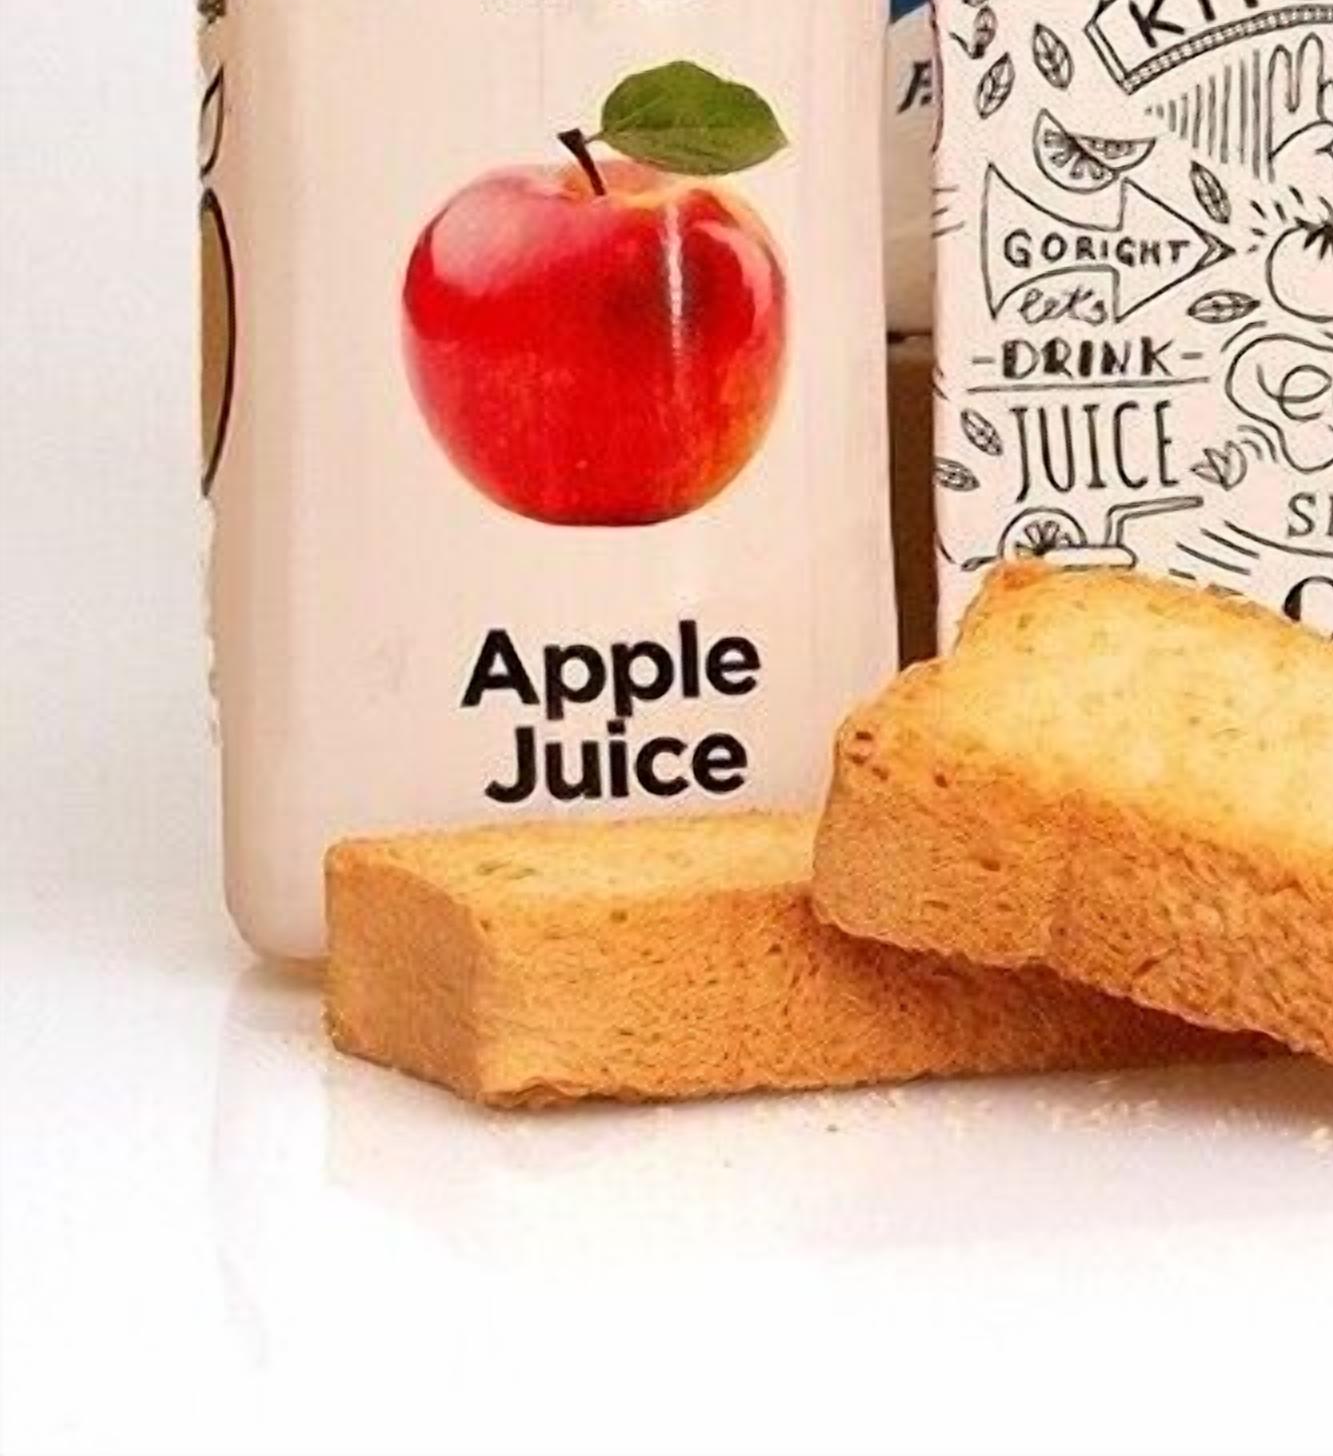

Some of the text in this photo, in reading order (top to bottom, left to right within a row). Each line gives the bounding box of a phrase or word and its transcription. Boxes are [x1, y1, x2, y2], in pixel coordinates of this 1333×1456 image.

[1001, 335, 1175, 380] DRINK
[1009, 400, 1181, 504] JUICE
[459, 619, 762, 721] Apple
[484, 719, 749, 804] Juice
